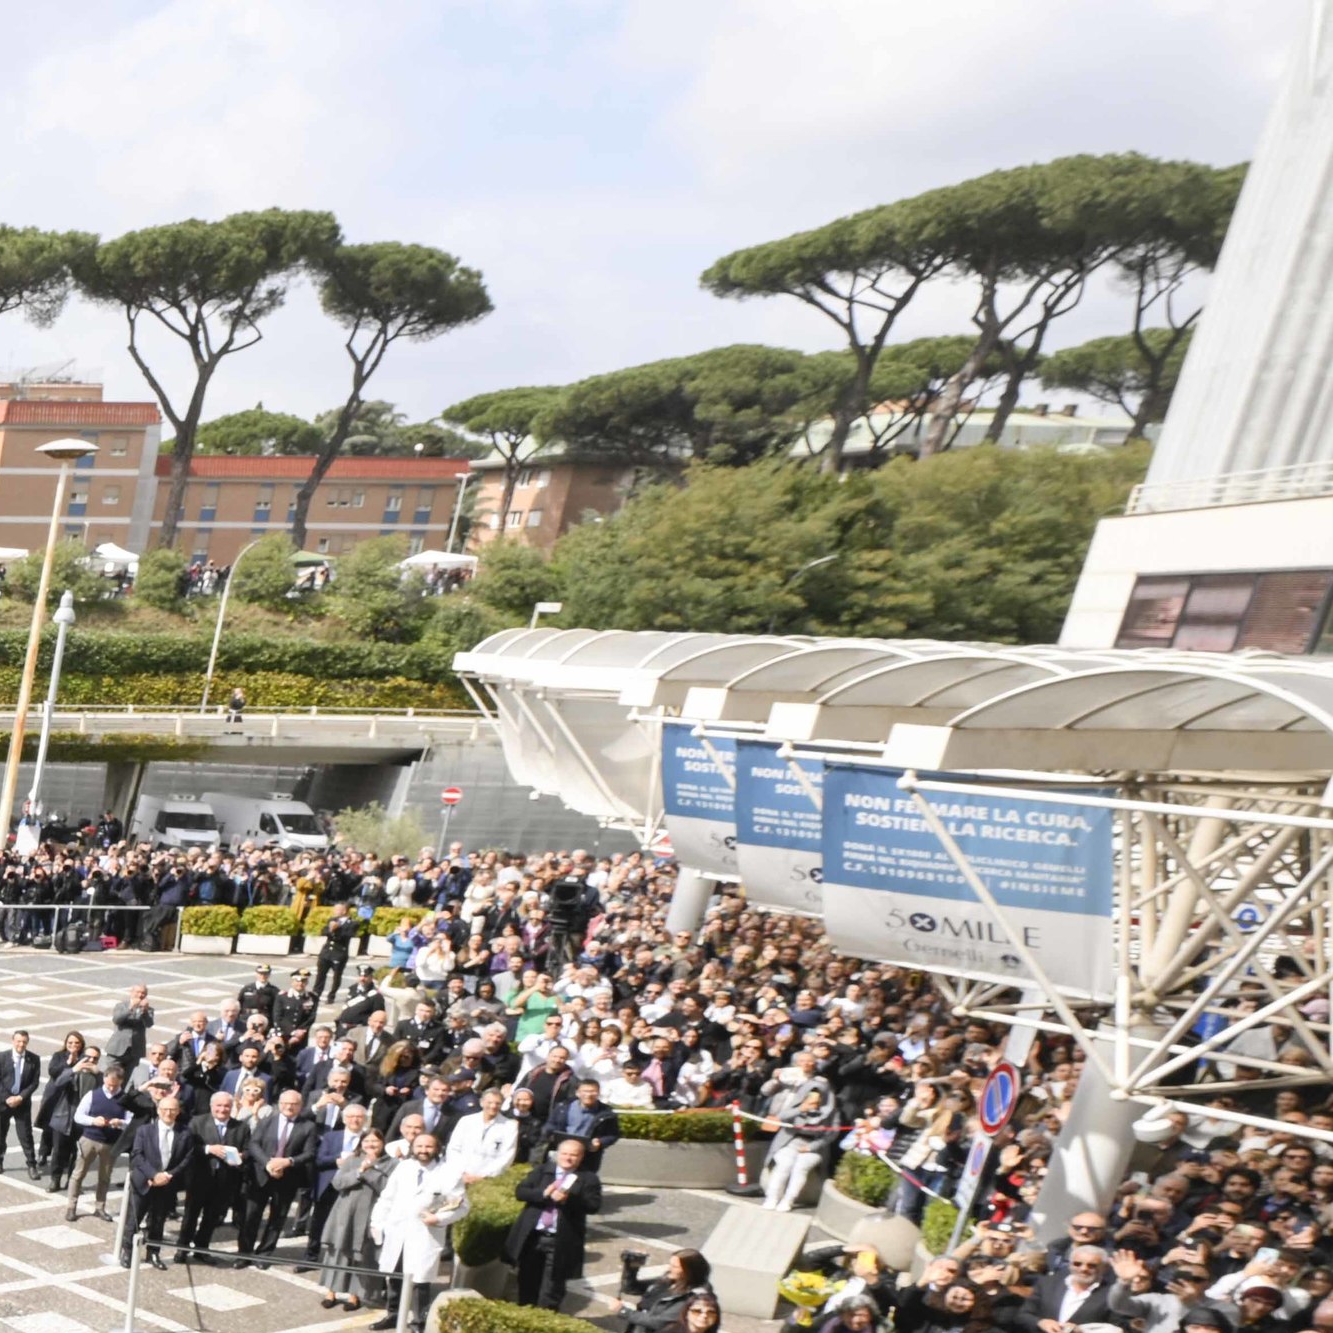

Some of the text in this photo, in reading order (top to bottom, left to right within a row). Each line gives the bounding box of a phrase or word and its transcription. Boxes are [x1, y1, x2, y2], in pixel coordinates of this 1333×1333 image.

[844, 793, 1093, 833] NON FEMARE LA CURA,
[855, 811, 1079, 846] SOSTIEN LA RICERCA.
[903, 937, 984, 963] Gemelli
